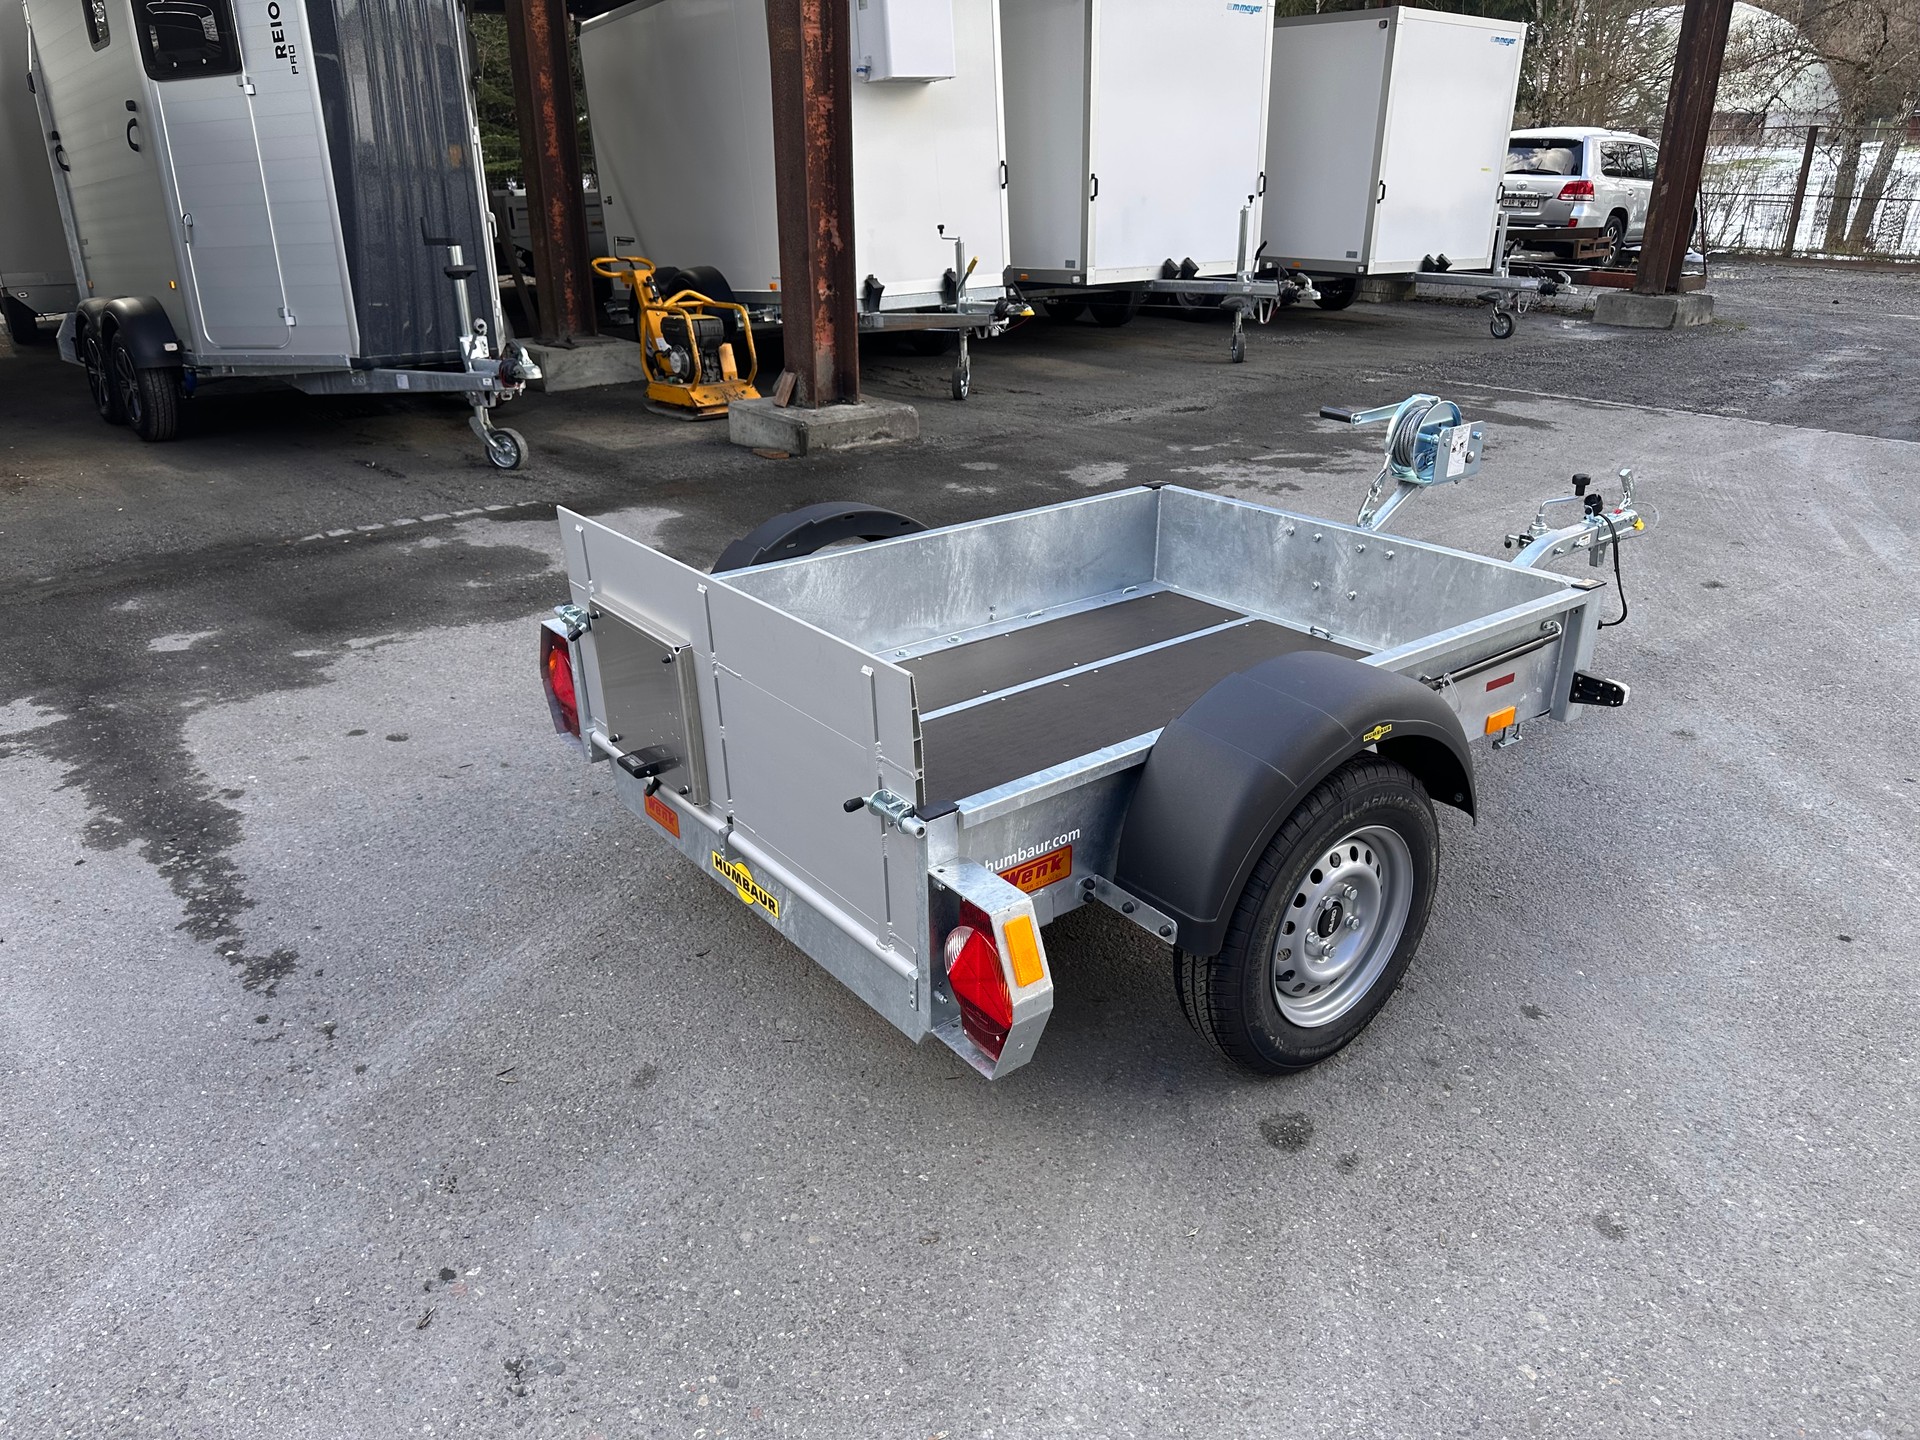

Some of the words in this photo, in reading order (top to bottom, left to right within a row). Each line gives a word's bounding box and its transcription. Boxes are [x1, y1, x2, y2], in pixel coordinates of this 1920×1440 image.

[268, 2, 287, 59] REIO
[288, 45, 299, 74] PRO
[985, 828, 1080, 872] humbaur.com
[714, 856, 777, 914] HUMBAUR
